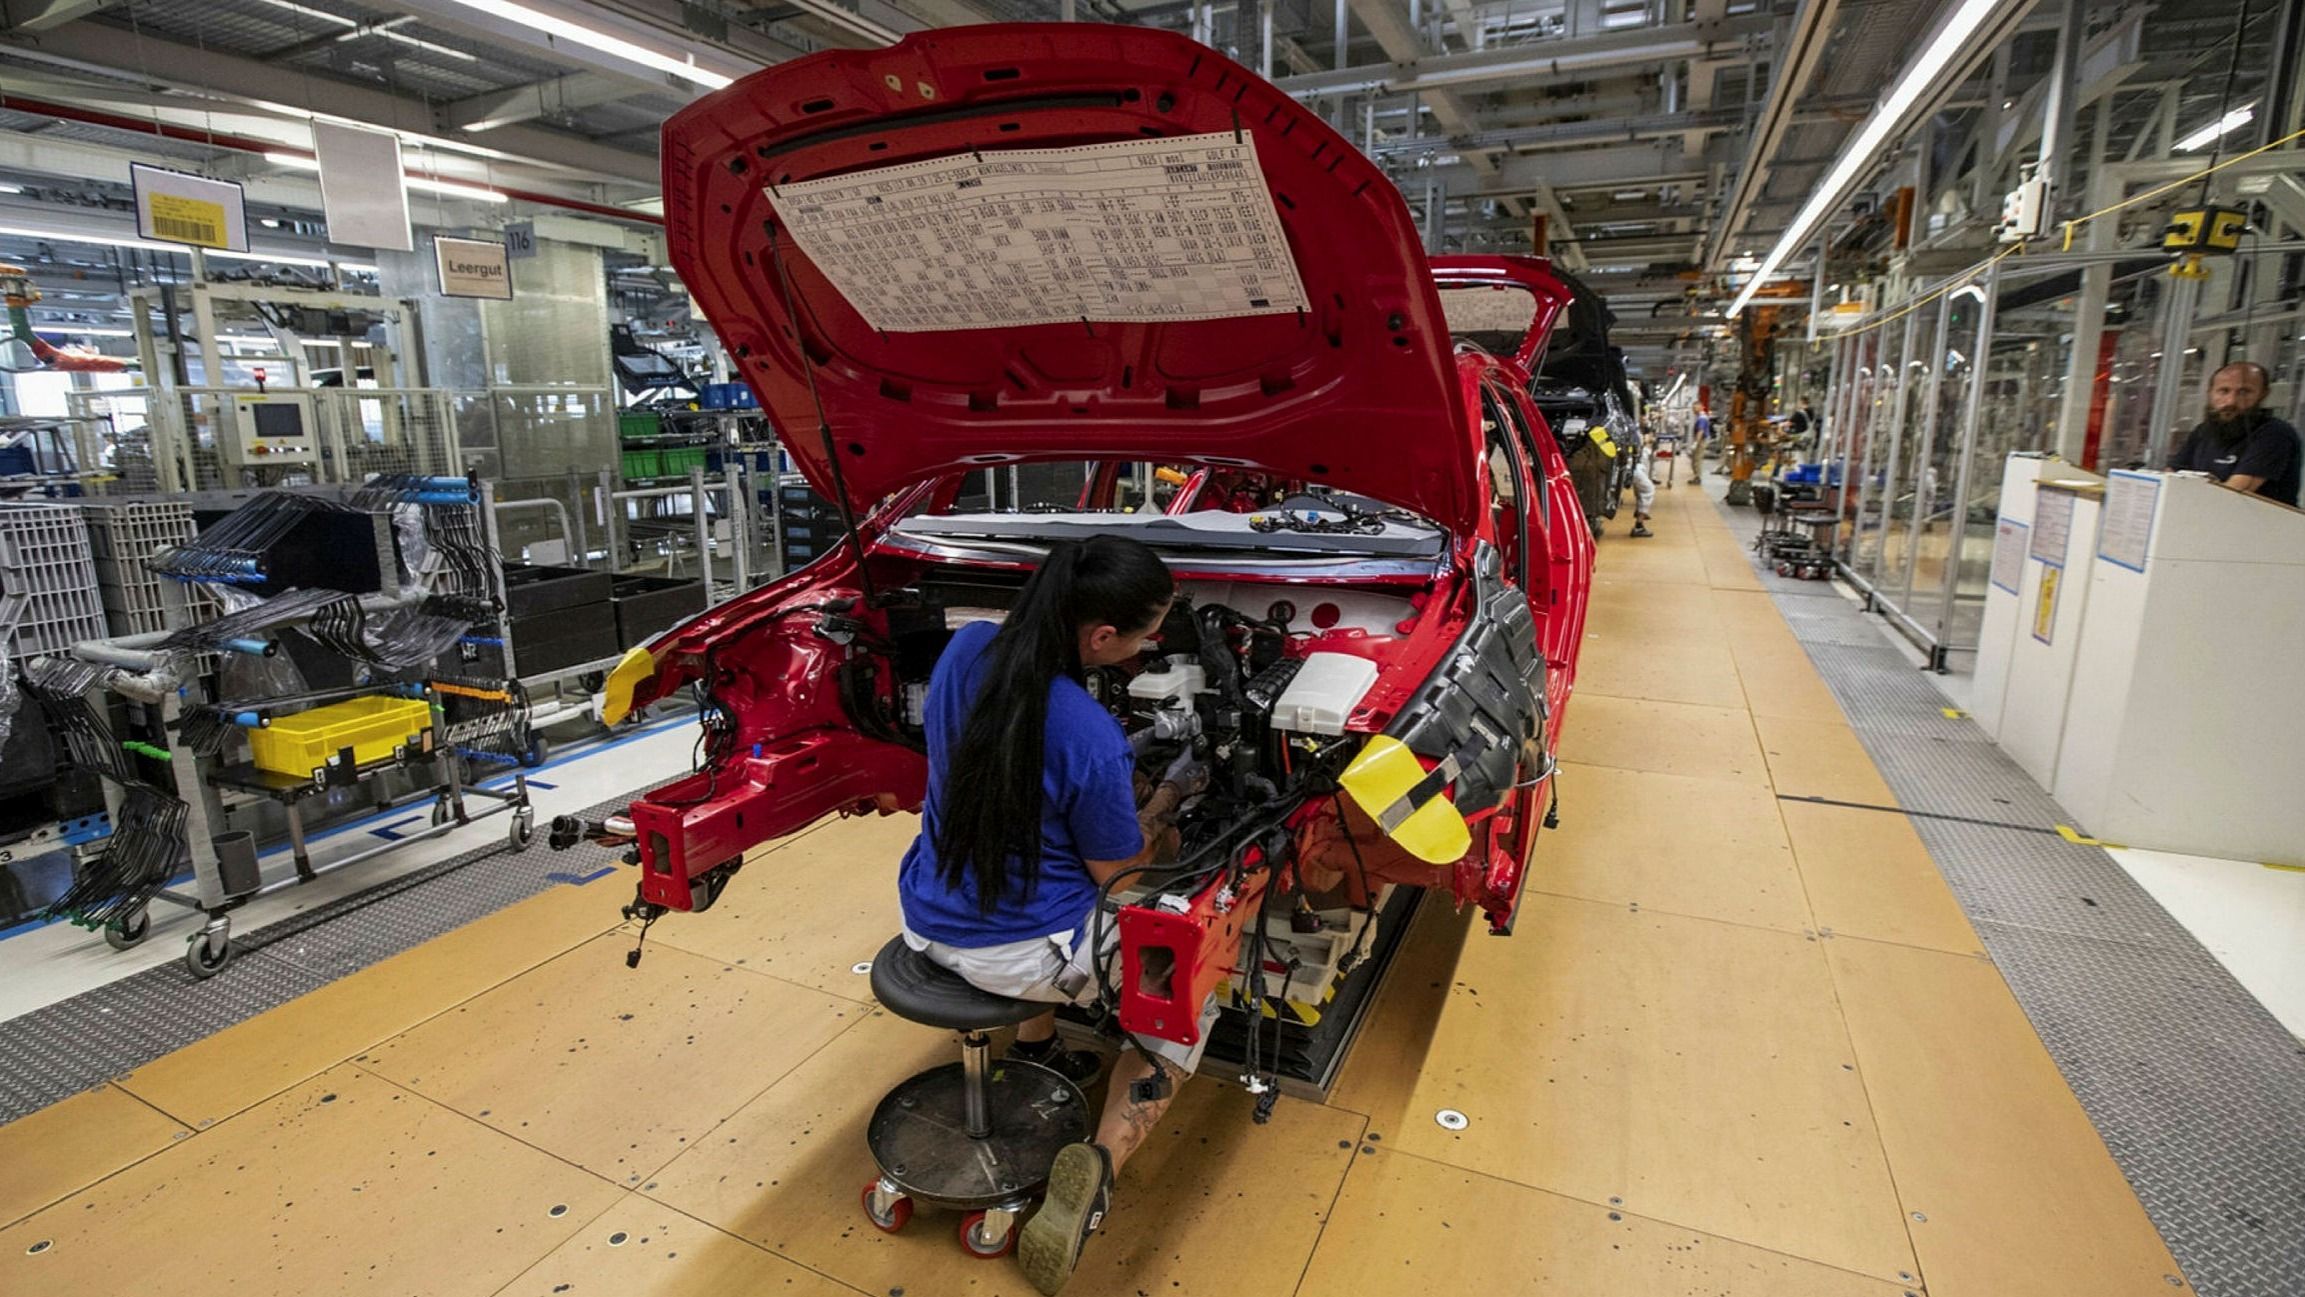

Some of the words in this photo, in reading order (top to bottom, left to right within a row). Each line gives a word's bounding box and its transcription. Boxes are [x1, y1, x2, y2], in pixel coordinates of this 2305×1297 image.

[1206, 150, 1224, 160] GOLF
[509, 231, 530, 250] 116
[448, 260, 502, 277] Leergut
